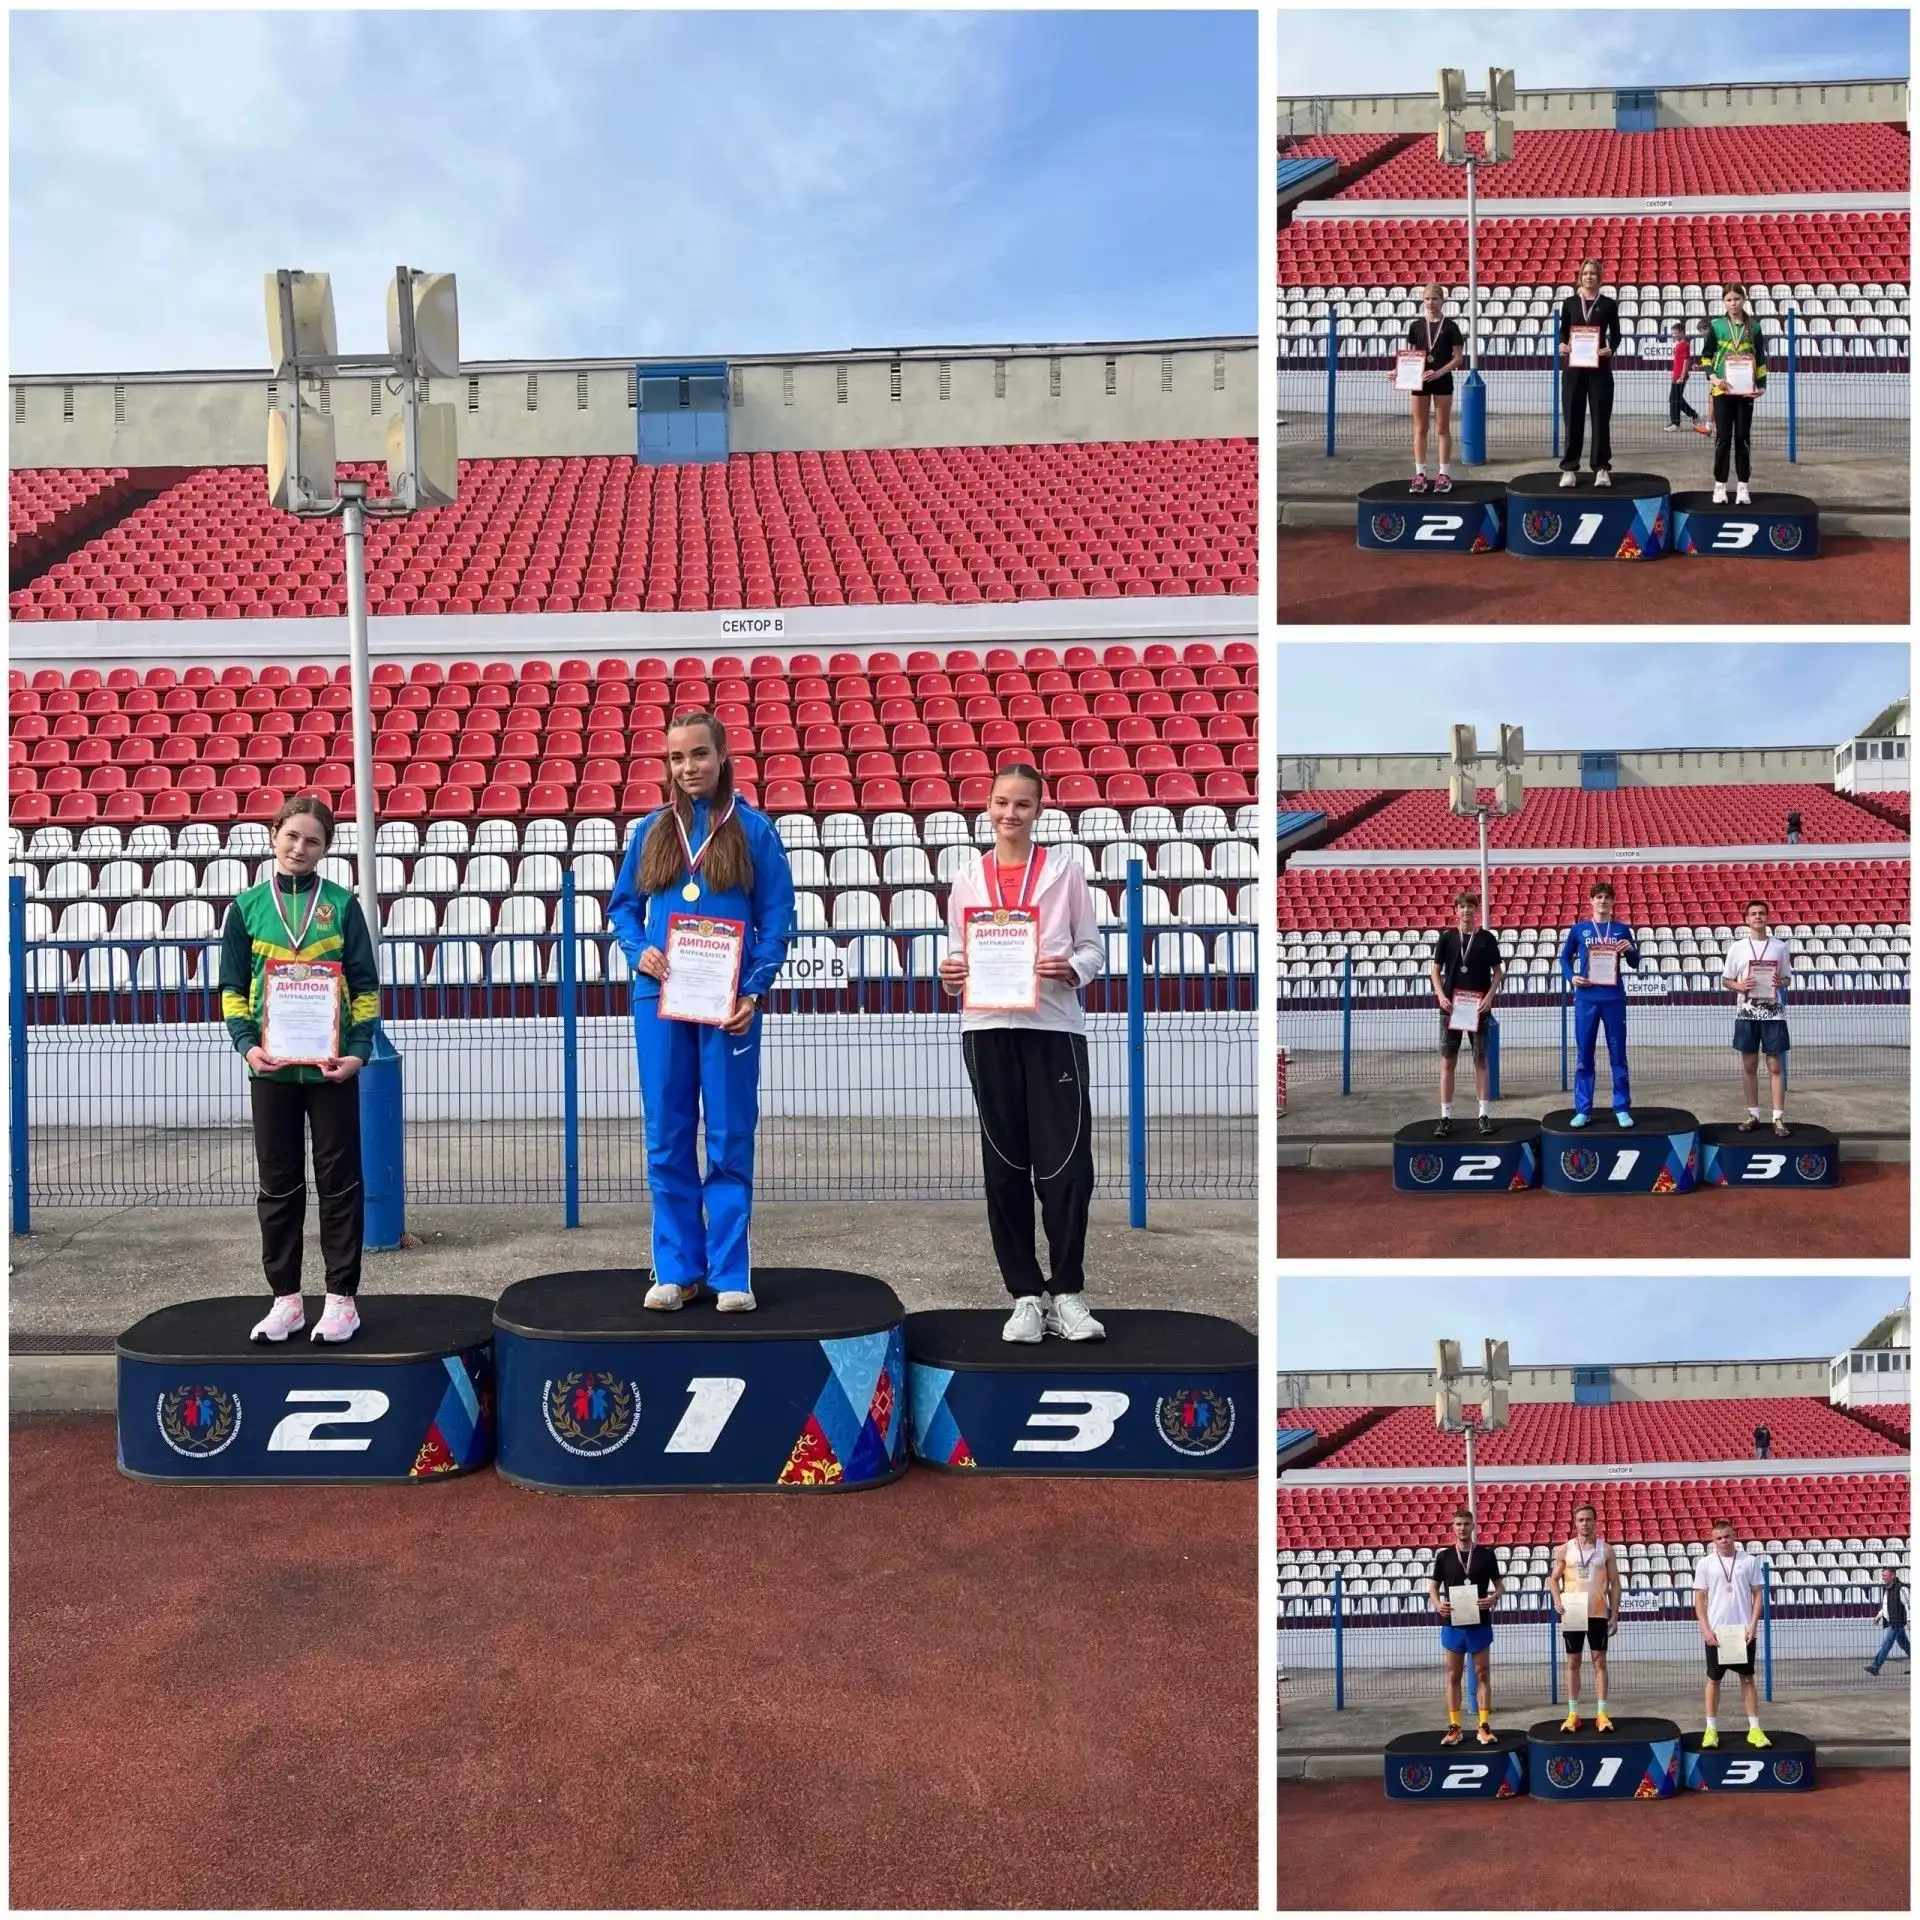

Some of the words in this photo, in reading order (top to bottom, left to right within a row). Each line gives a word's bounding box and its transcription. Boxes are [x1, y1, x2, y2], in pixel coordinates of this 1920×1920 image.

[1644, 347, 1676, 356] СЕКТО
[1415, 516, 1463, 541] 2
[1571, 514, 1603, 544] 1
[1712, 523, 1759, 548] 3
[722, 619, 771, 632] СЕКТОР
[775, 619, 784, 631] В
[677, 937, 730, 951] ДИПЛОМ
[975, 928, 1029, 939] ДИПЛОМ
[779, 959, 824, 978] ТОР
[831, 959, 844, 977] В
[276, 982, 329, 992] ДИПЛОМ
[1627, 983, 1658, 992] СЕКТОР
[1660, 983, 1667, 991] В
[1453, 1156, 1501, 1181] 2
[1609, 1151, 1639, 1180] 1
[1742, 1154, 1786, 1179] 3
[267, 1390, 389, 1451] 2
[664, 1378, 746, 1452] 1
[1012, 1391, 1130, 1451] 3
[1442, 1765, 1488, 1789] 2
[1593, 1757, 1623, 1787] 1
[1722, 1761, 1765, 1785] 3
